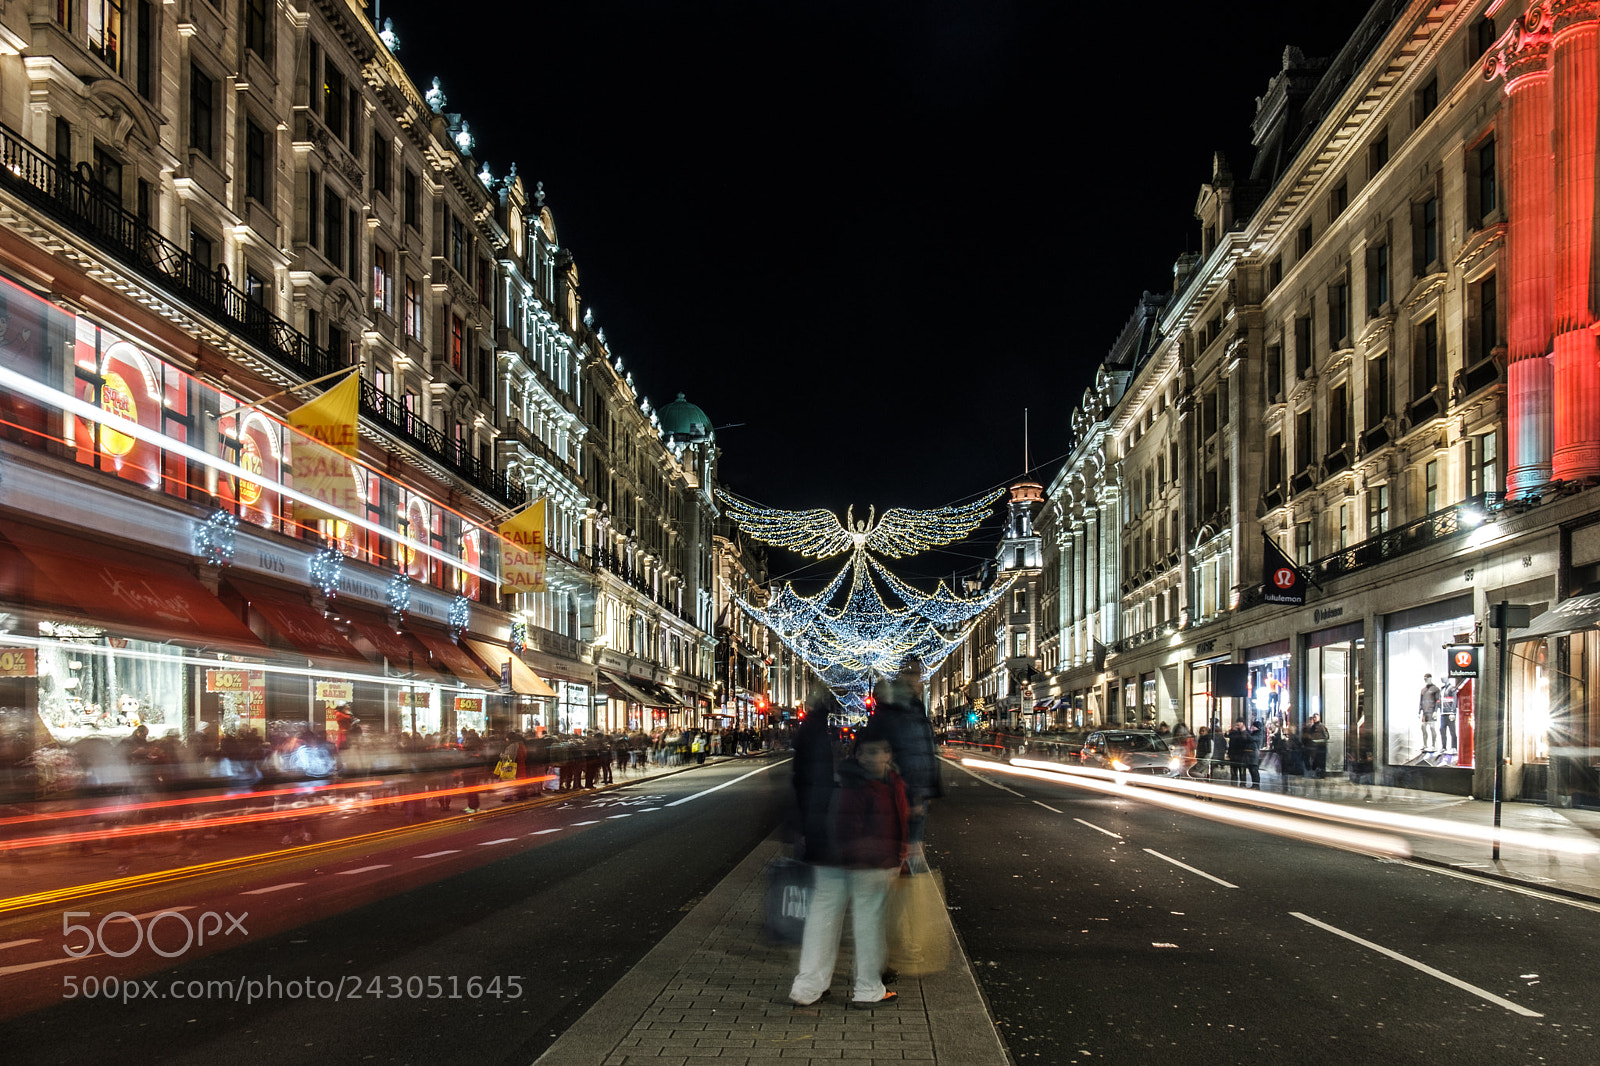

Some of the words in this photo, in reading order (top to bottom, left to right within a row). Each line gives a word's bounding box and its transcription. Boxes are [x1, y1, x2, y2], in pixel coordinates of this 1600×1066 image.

[292, 424, 355, 446] SALE
[293, 456, 354, 478] SALE
[503, 531, 542, 545] SALE
[258, 551, 285, 574] TOYS
[504, 552, 542, 566] SALE
[505, 572, 543, 586] SALE
[340, 577, 379, 600] HAMLEYS
[1264, 594, 1302, 603] lululemon
[0, 652, 25, 670] 0%
[215, 673, 242, 687] 50%
